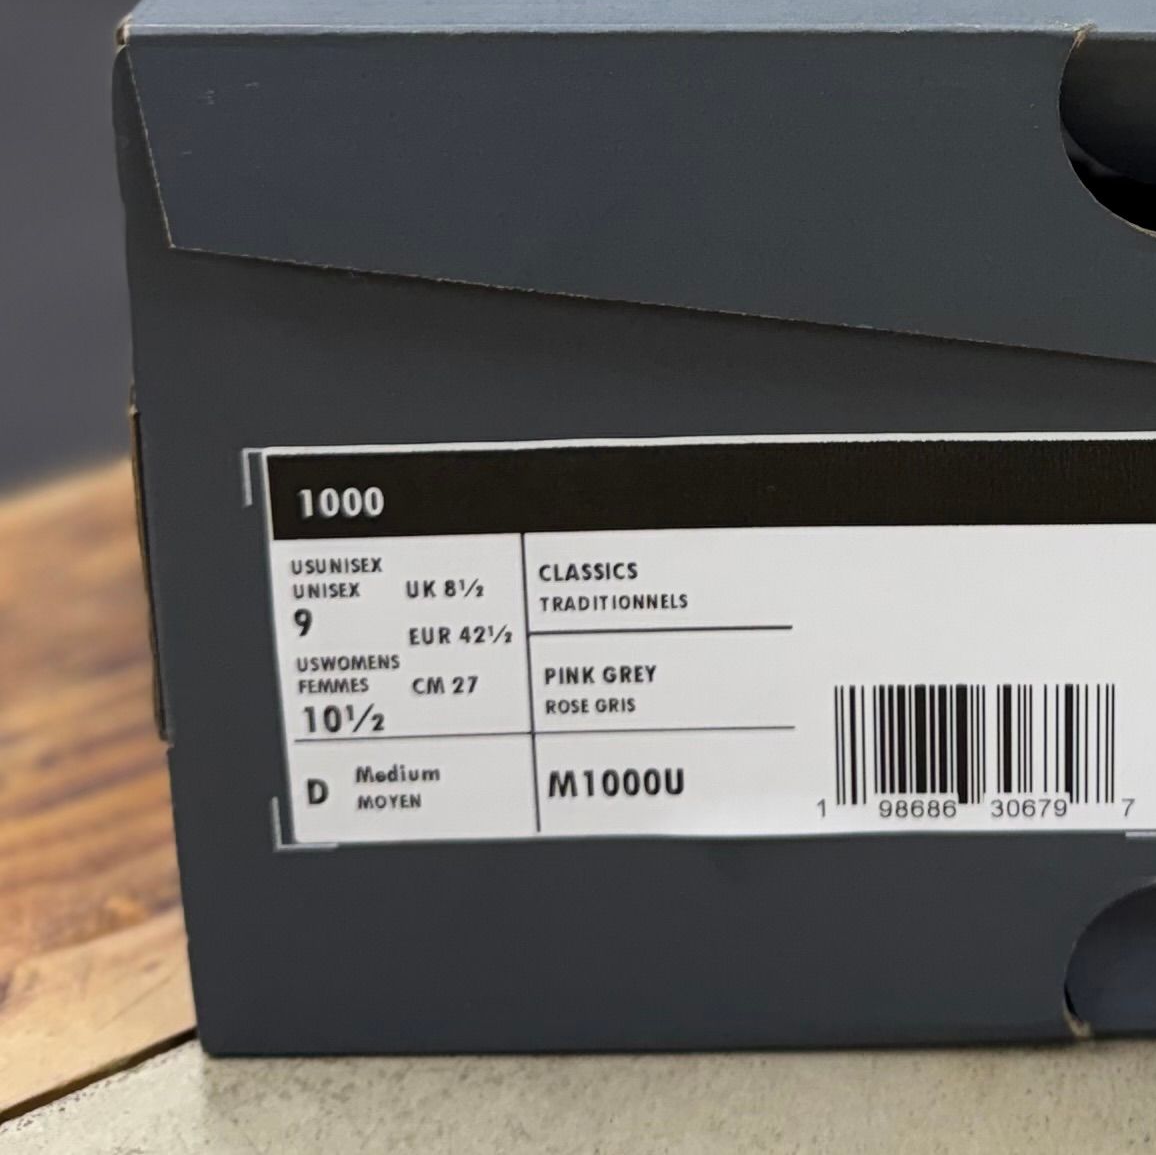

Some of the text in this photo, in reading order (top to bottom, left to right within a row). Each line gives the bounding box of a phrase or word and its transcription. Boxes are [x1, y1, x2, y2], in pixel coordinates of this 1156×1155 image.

[299, 486, 385, 519] 1000
[291, 557, 383, 575] USUNISEX
[539, 562, 638, 582] CLASSICS
[293, 582, 361, 599] UNISEX
[406, 580, 436, 598] UK
[540, 593, 689, 613] TRADITIONNELS
[294, 608, 313, 637] 9
[409, 627, 451, 645] EUR
[297, 655, 400, 672] USWOMENS
[545, 665, 657, 685] PINK GREY
[299, 678, 370, 694] FEMMES
[412, 676, 479, 695] CM 27
[546, 698, 636, 715] ROSE GRIS
[356, 766, 440, 784] Medium
[548, 769, 684, 797] M1000U
[307, 779, 328, 805] D
[358, 794, 421, 810] MOYEN
[817, 799, 1135, 818] 1 98686 30679 7
